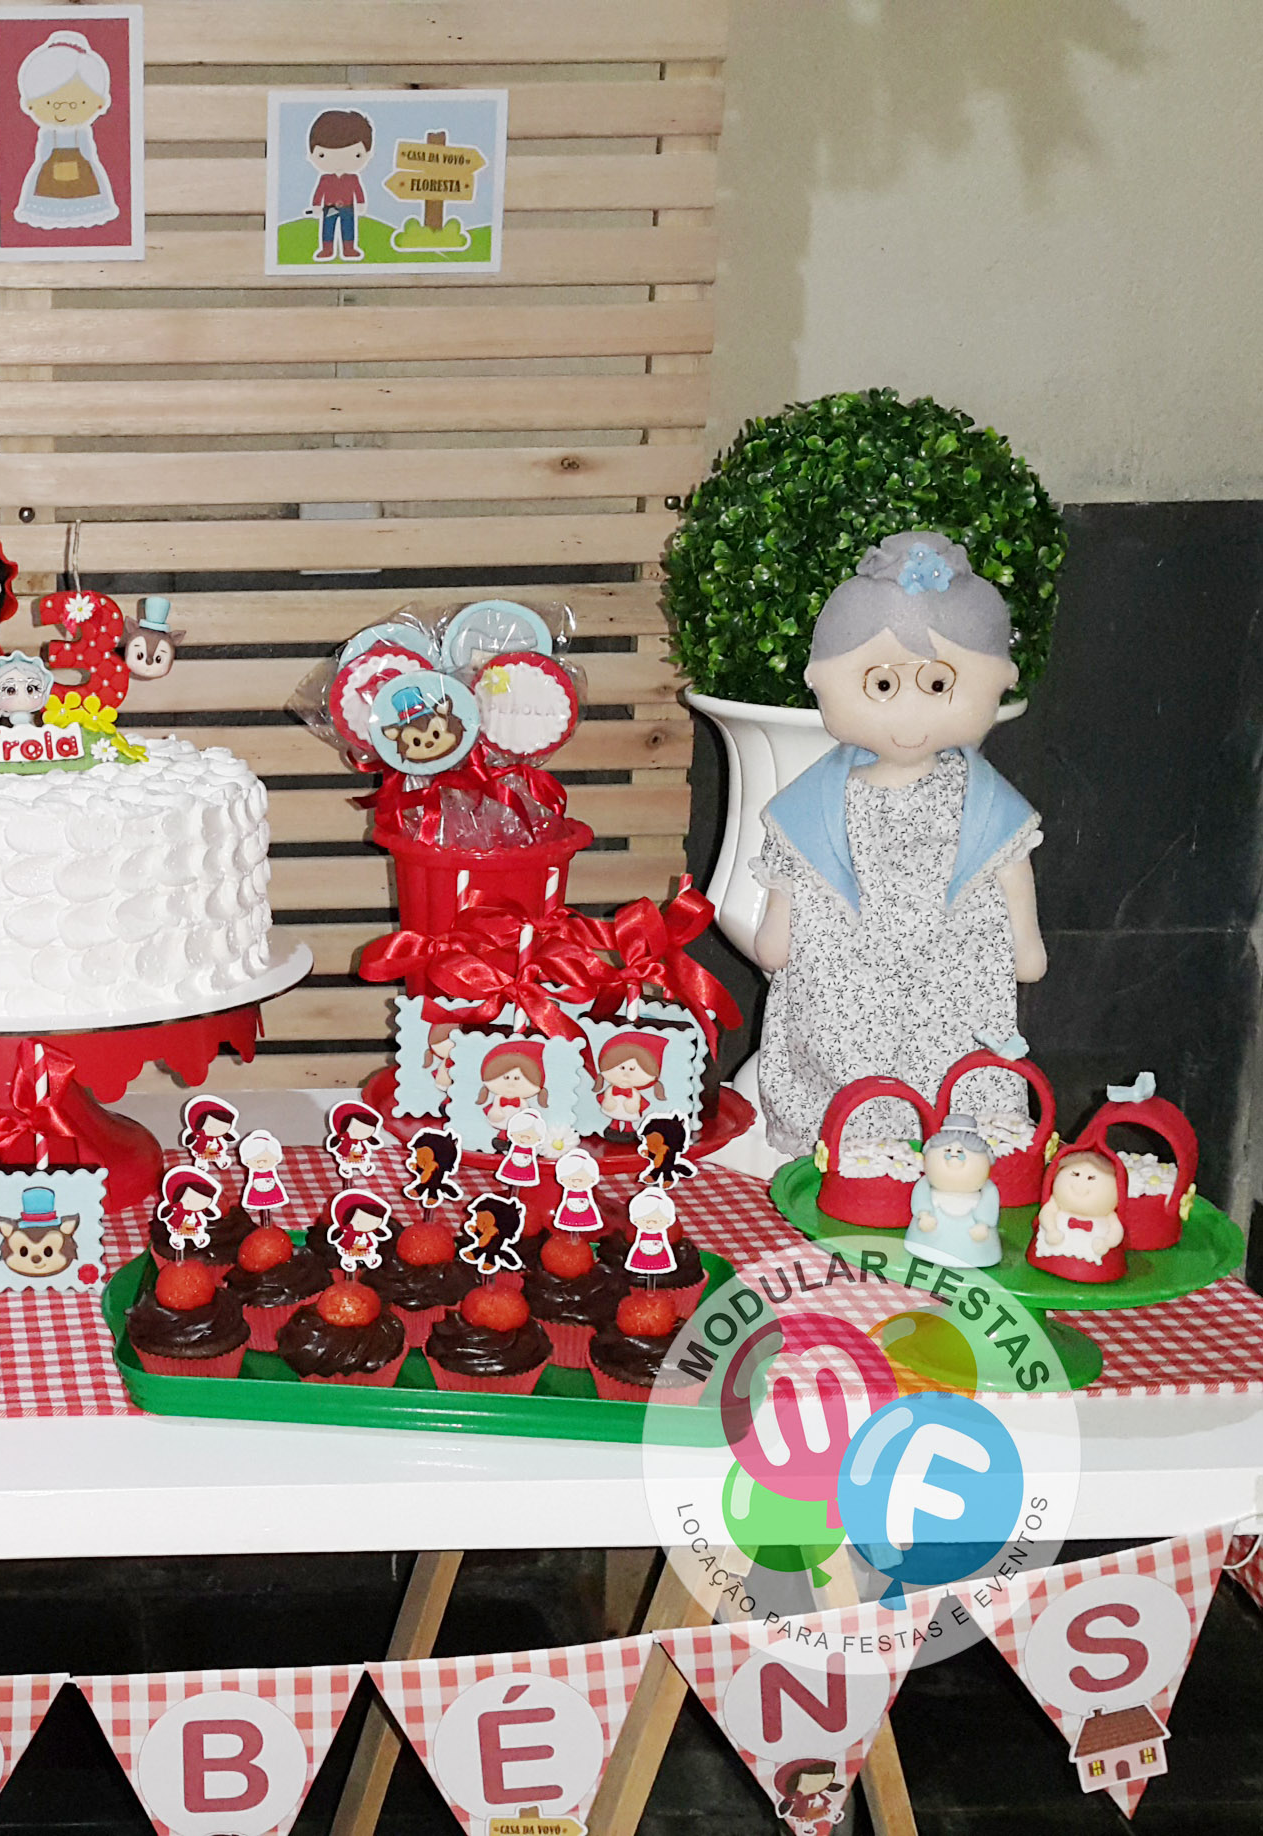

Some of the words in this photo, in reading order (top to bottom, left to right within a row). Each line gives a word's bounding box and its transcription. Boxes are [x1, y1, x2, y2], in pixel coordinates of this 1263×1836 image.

[407, 150, 426, 162] CASA
[428, 152, 440, 163] DA
[410, 178, 461, 192] FLORESTA
[39, 589, 130, 711] 3
[500, 1825, 520, 1835] CASA
[523, 1825, 535, 1835] DA
